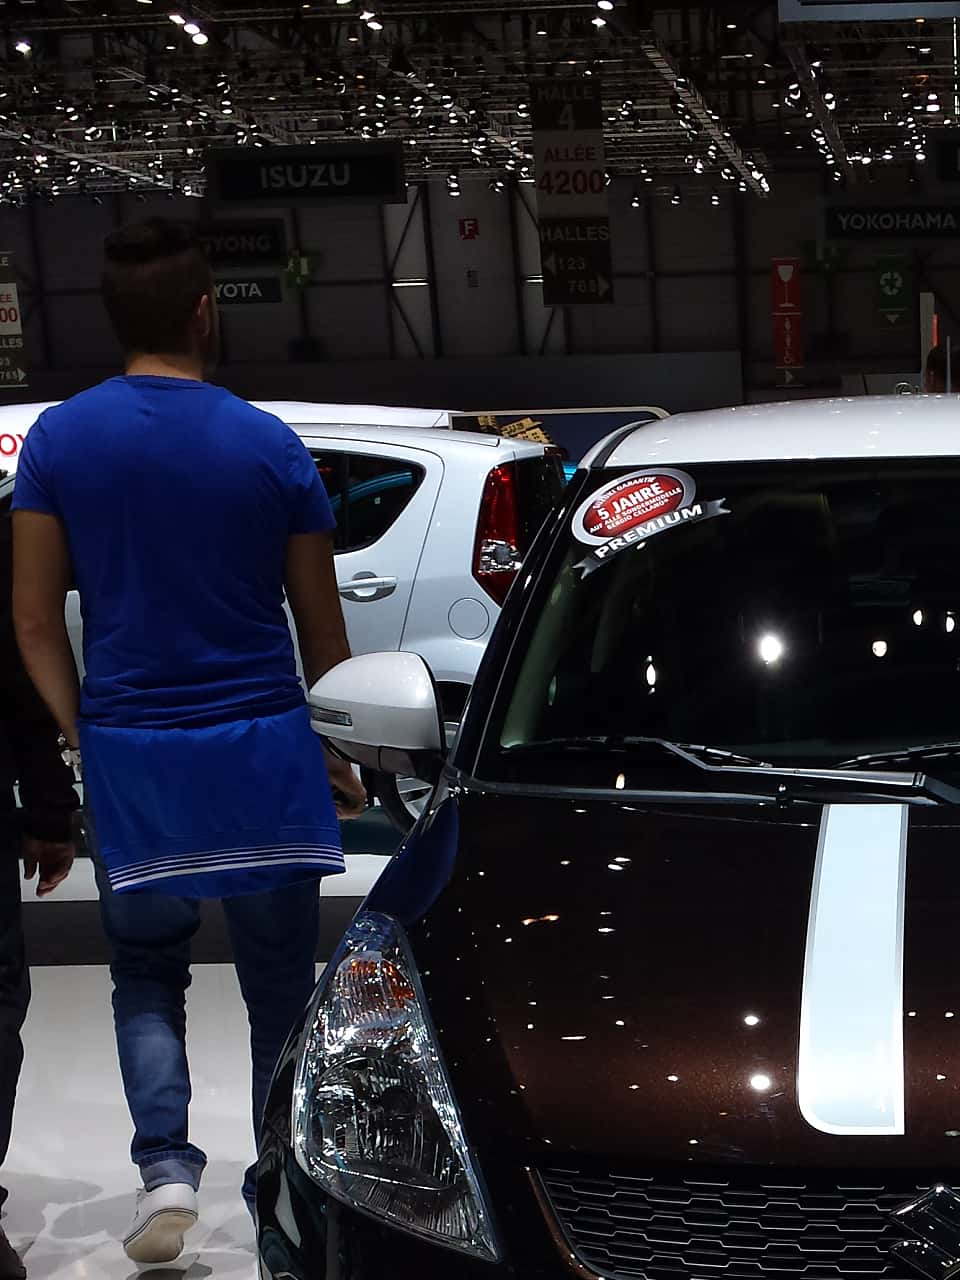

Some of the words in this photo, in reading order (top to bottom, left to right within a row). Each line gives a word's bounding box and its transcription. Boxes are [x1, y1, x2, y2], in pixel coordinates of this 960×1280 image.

[558, 103, 575, 134] 4
[260, 162, 350, 190] ISUZU
[536, 170, 604, 194] 4200
[540, 224, 609, 241] HALLES
[837, 212, 957, 232] YOKOHAMA
[597, 507, 610, 520] 5
[612, 482, 664, 514] JAHRE
[594, 503, 703, 558] PREMIUM
